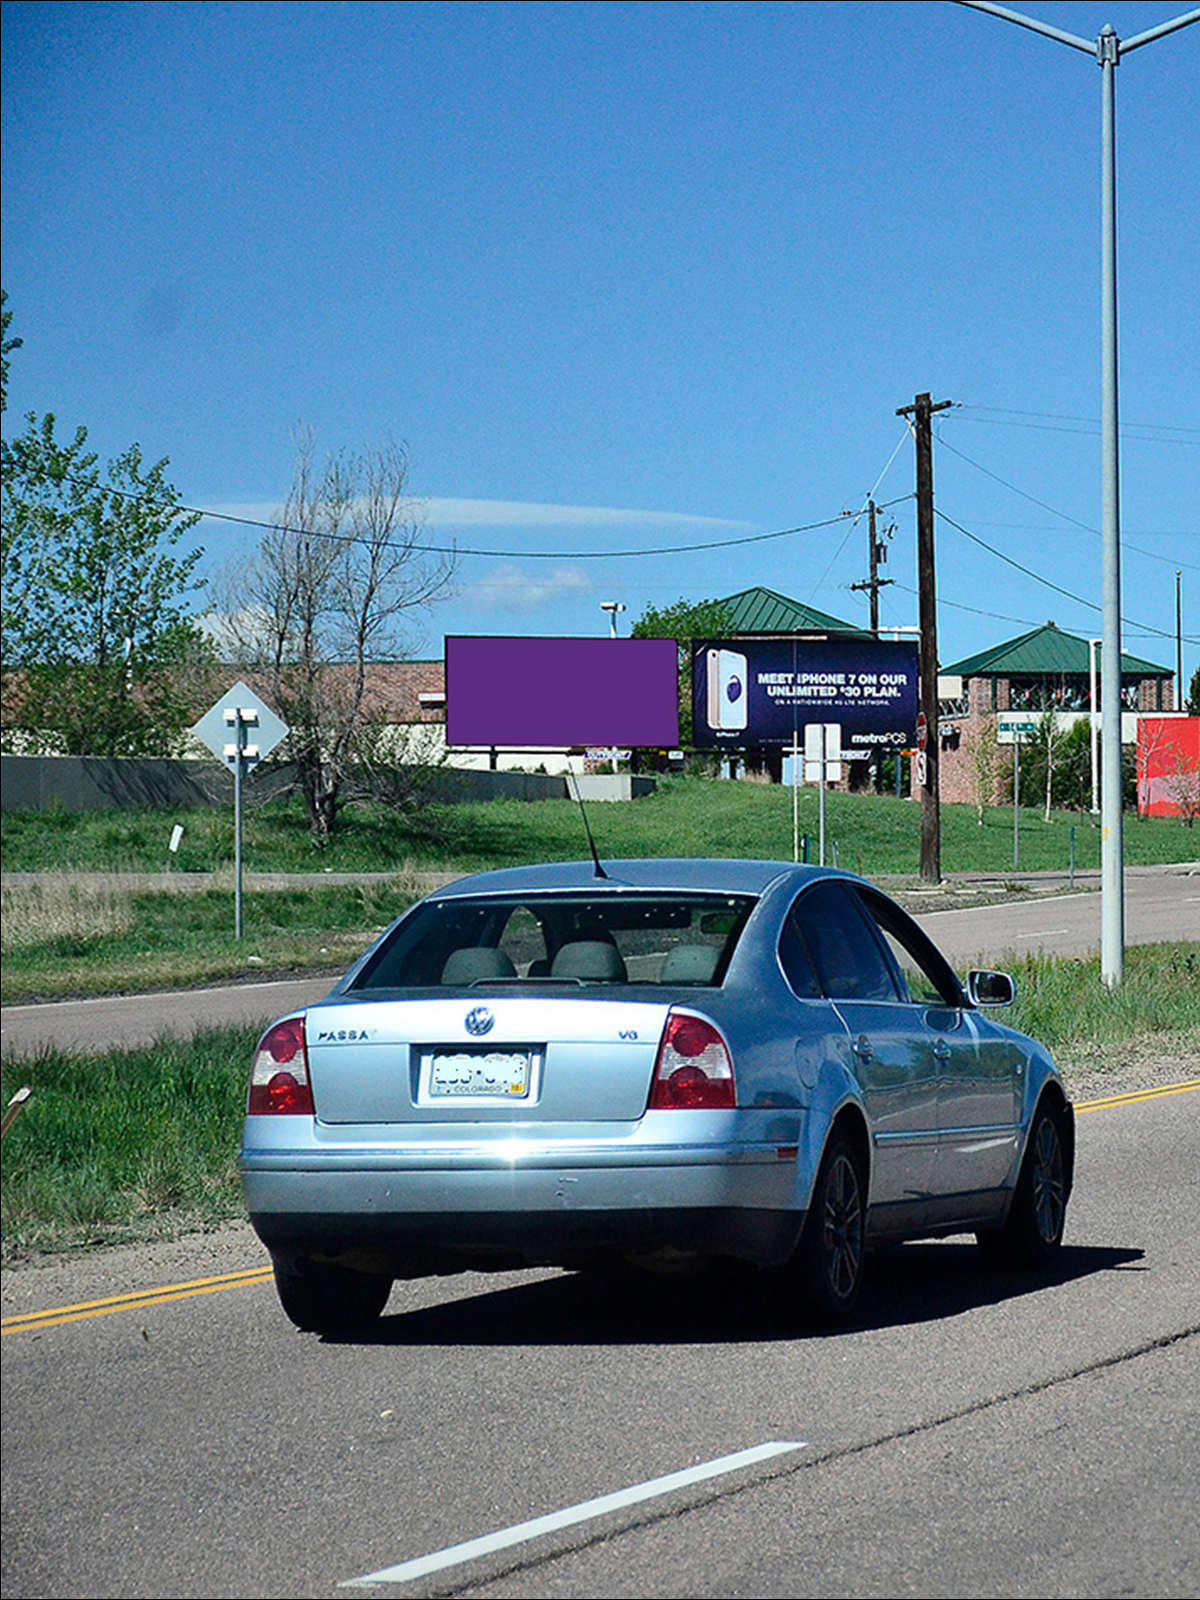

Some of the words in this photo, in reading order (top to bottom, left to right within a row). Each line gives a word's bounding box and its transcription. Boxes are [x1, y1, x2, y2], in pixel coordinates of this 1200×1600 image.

[757, 673, 794, 685] MEET
[797, 673, 846, 685] IPHONE
[848, 674, 856, 685] 7
[858, 673, 877, 685] ON
[879, 673, 907, 685] OUR
[767, 685, 838, 697] UNLIMITED
[863, 686, 901, 697] PLAN.
[851, 732, 907, 745] metroPCS
